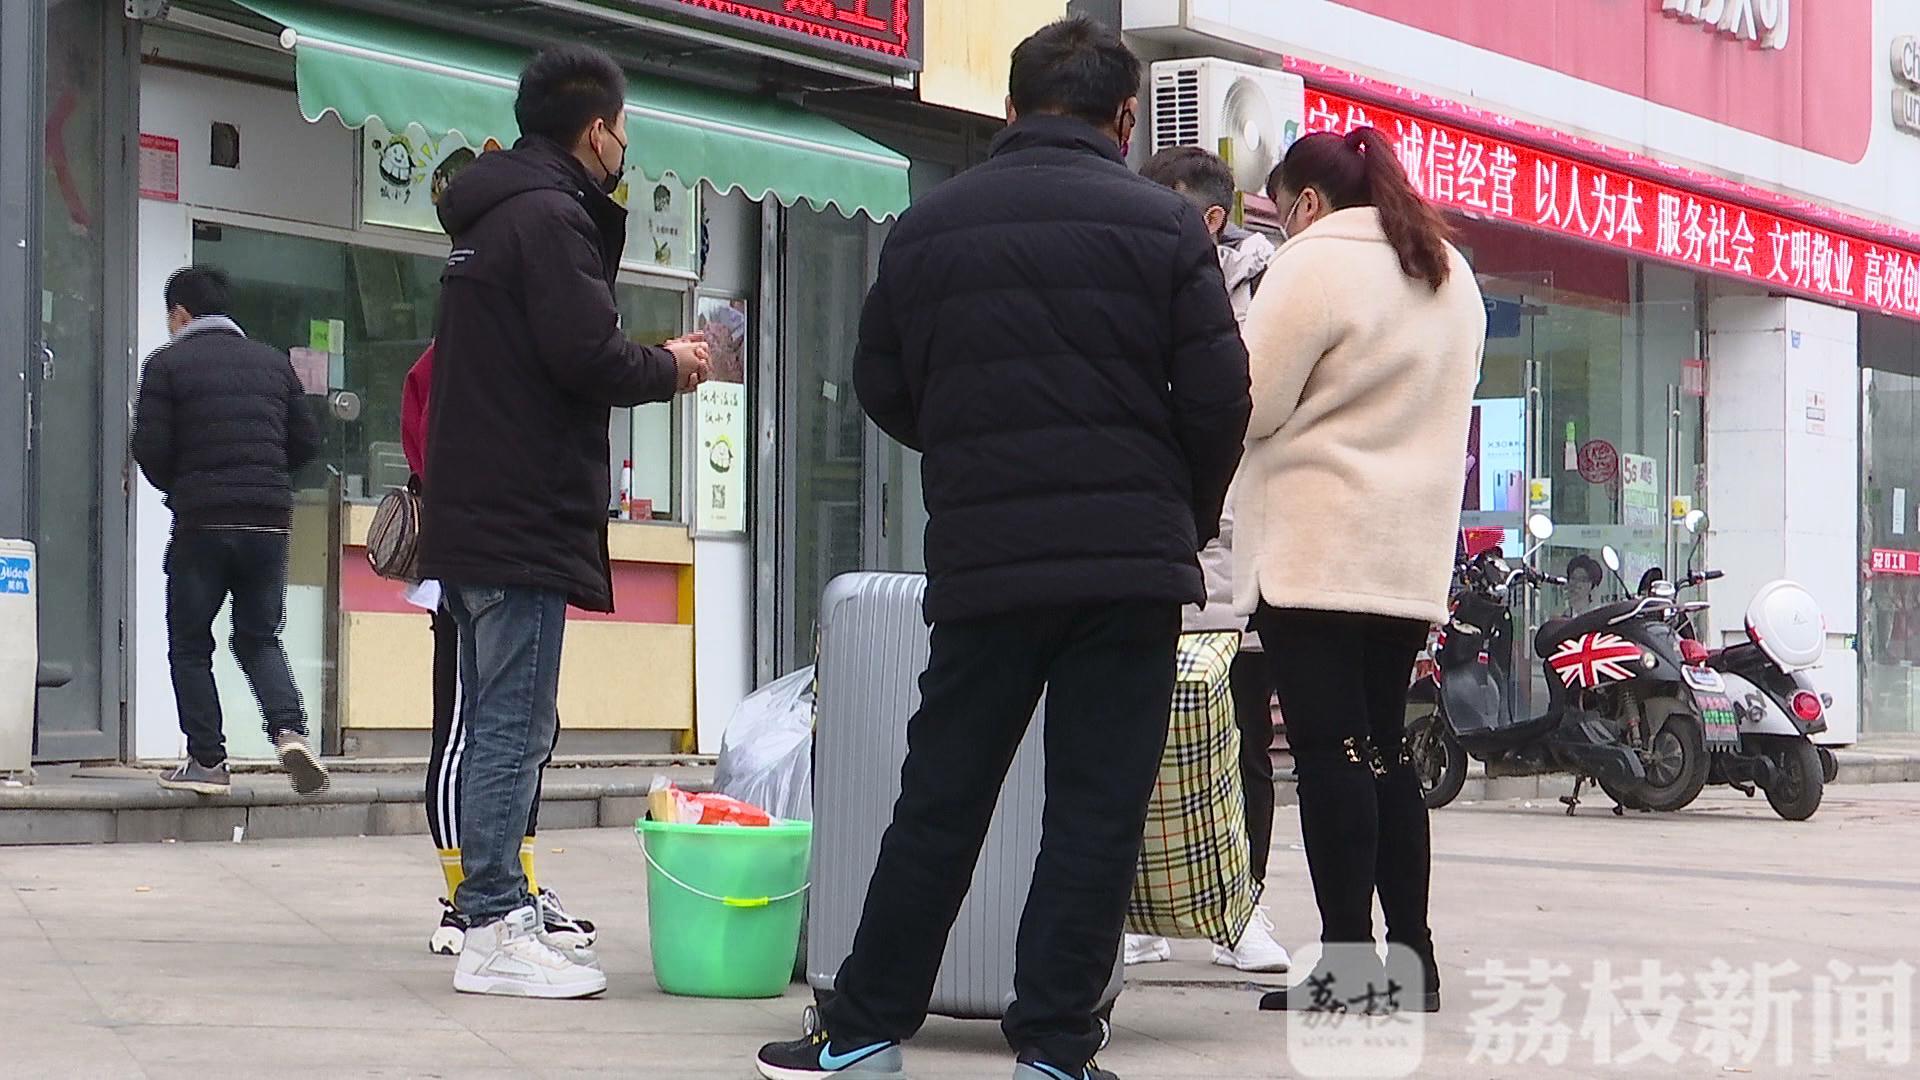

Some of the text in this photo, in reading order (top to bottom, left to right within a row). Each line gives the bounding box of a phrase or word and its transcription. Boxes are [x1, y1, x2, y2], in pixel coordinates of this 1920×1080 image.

[1393, 119, 1518, 217] 诚信经营
[1535, 159, 1643, 247] 以人为本
[1655, 191, 1755, 276] 服务社会
[1766, 221, 1854, 296] 文明敬业
